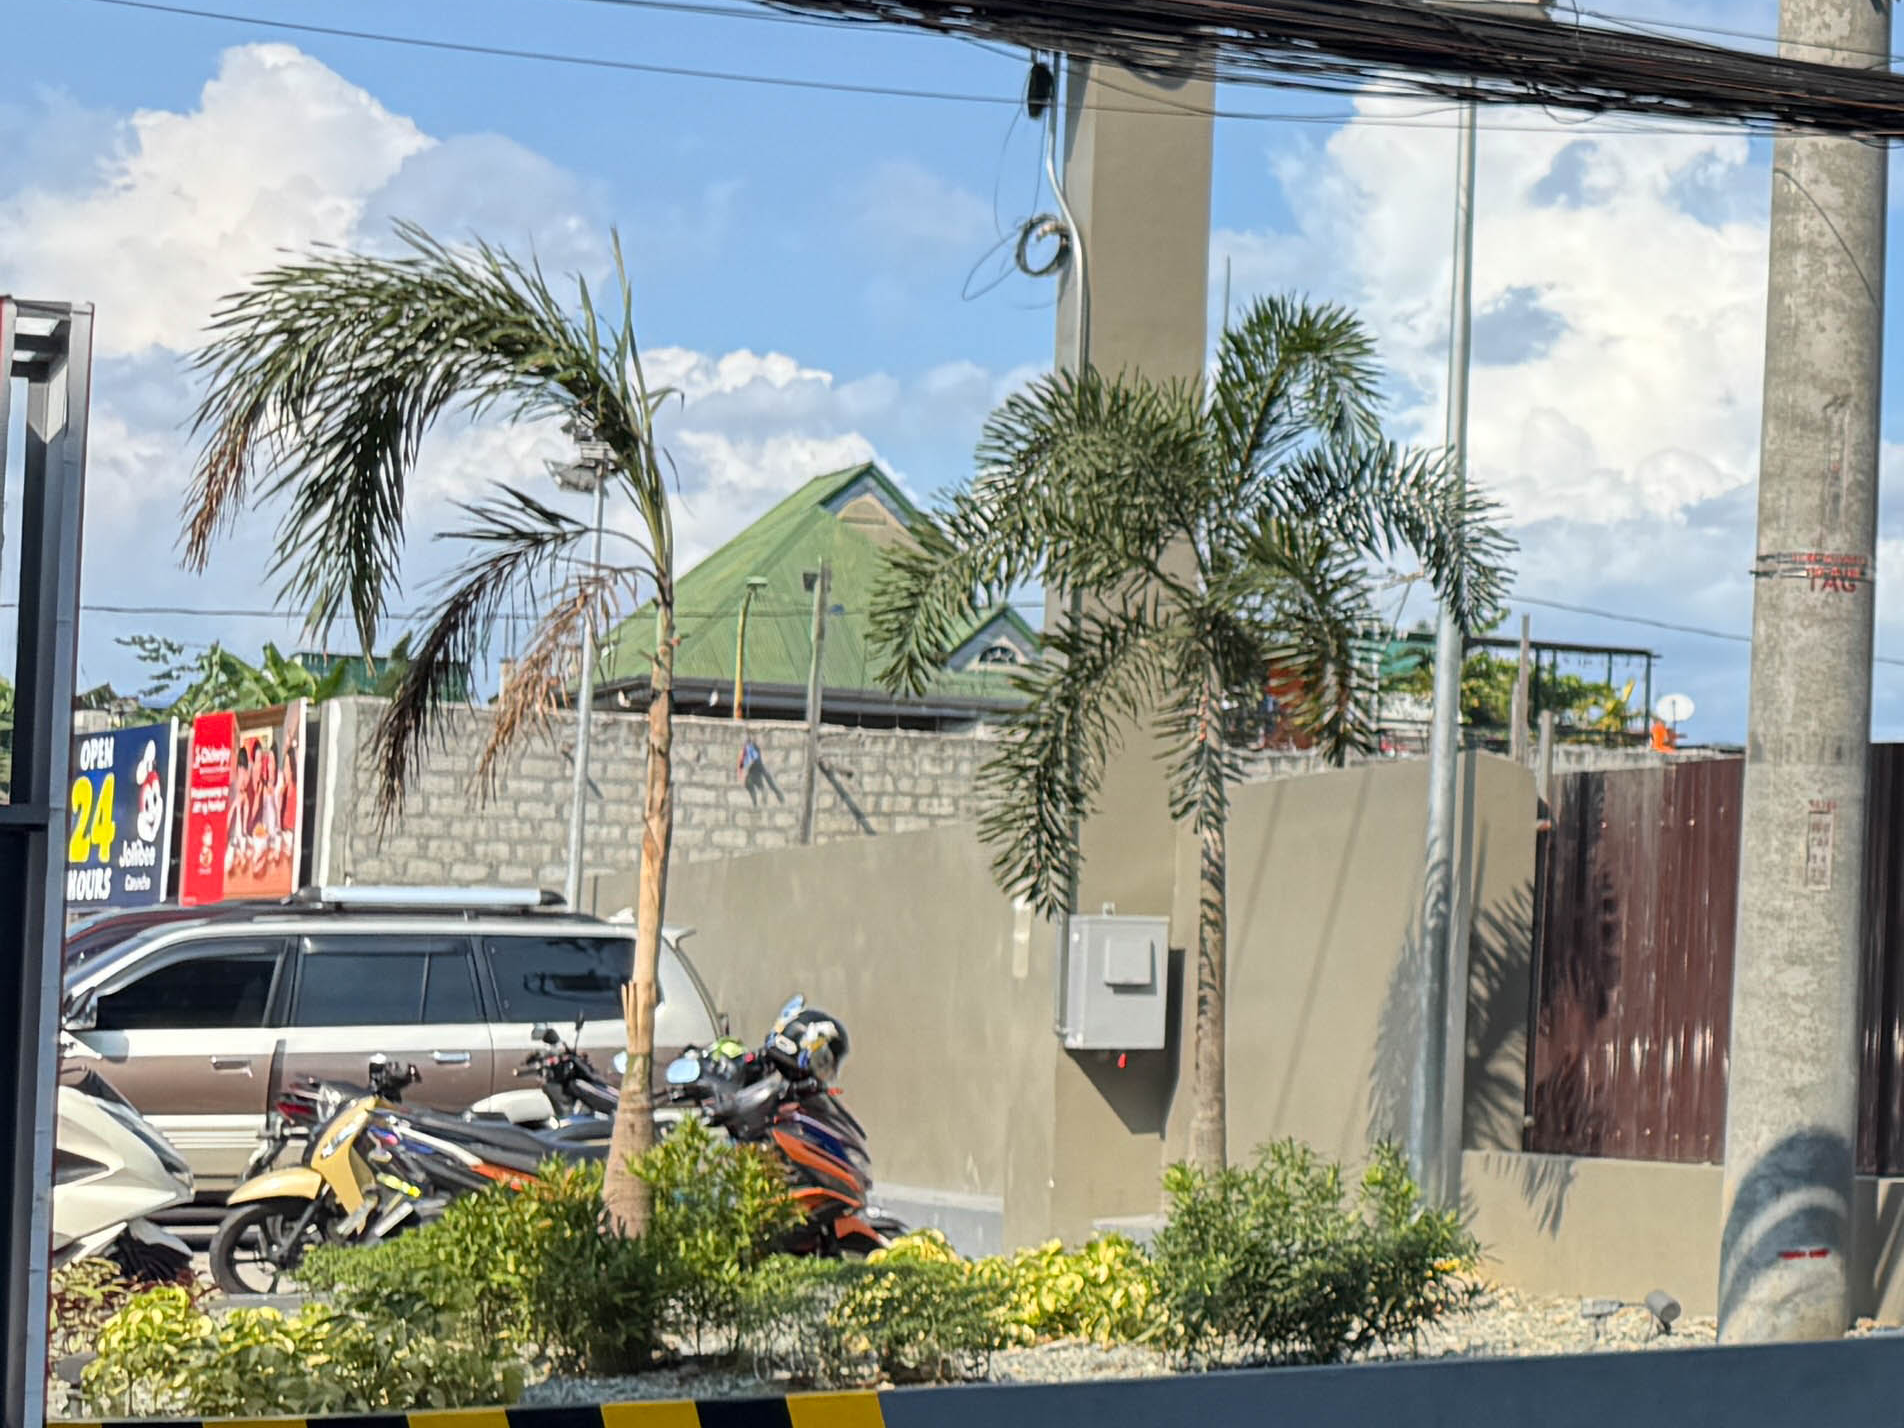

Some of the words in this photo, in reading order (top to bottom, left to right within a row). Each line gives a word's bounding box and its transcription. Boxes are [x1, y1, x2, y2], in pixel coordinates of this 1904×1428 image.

[80, 736, 115, 771] OPEN
[68, 771, 116, 864] 24
[66, 867, 112, 901] HOURS
